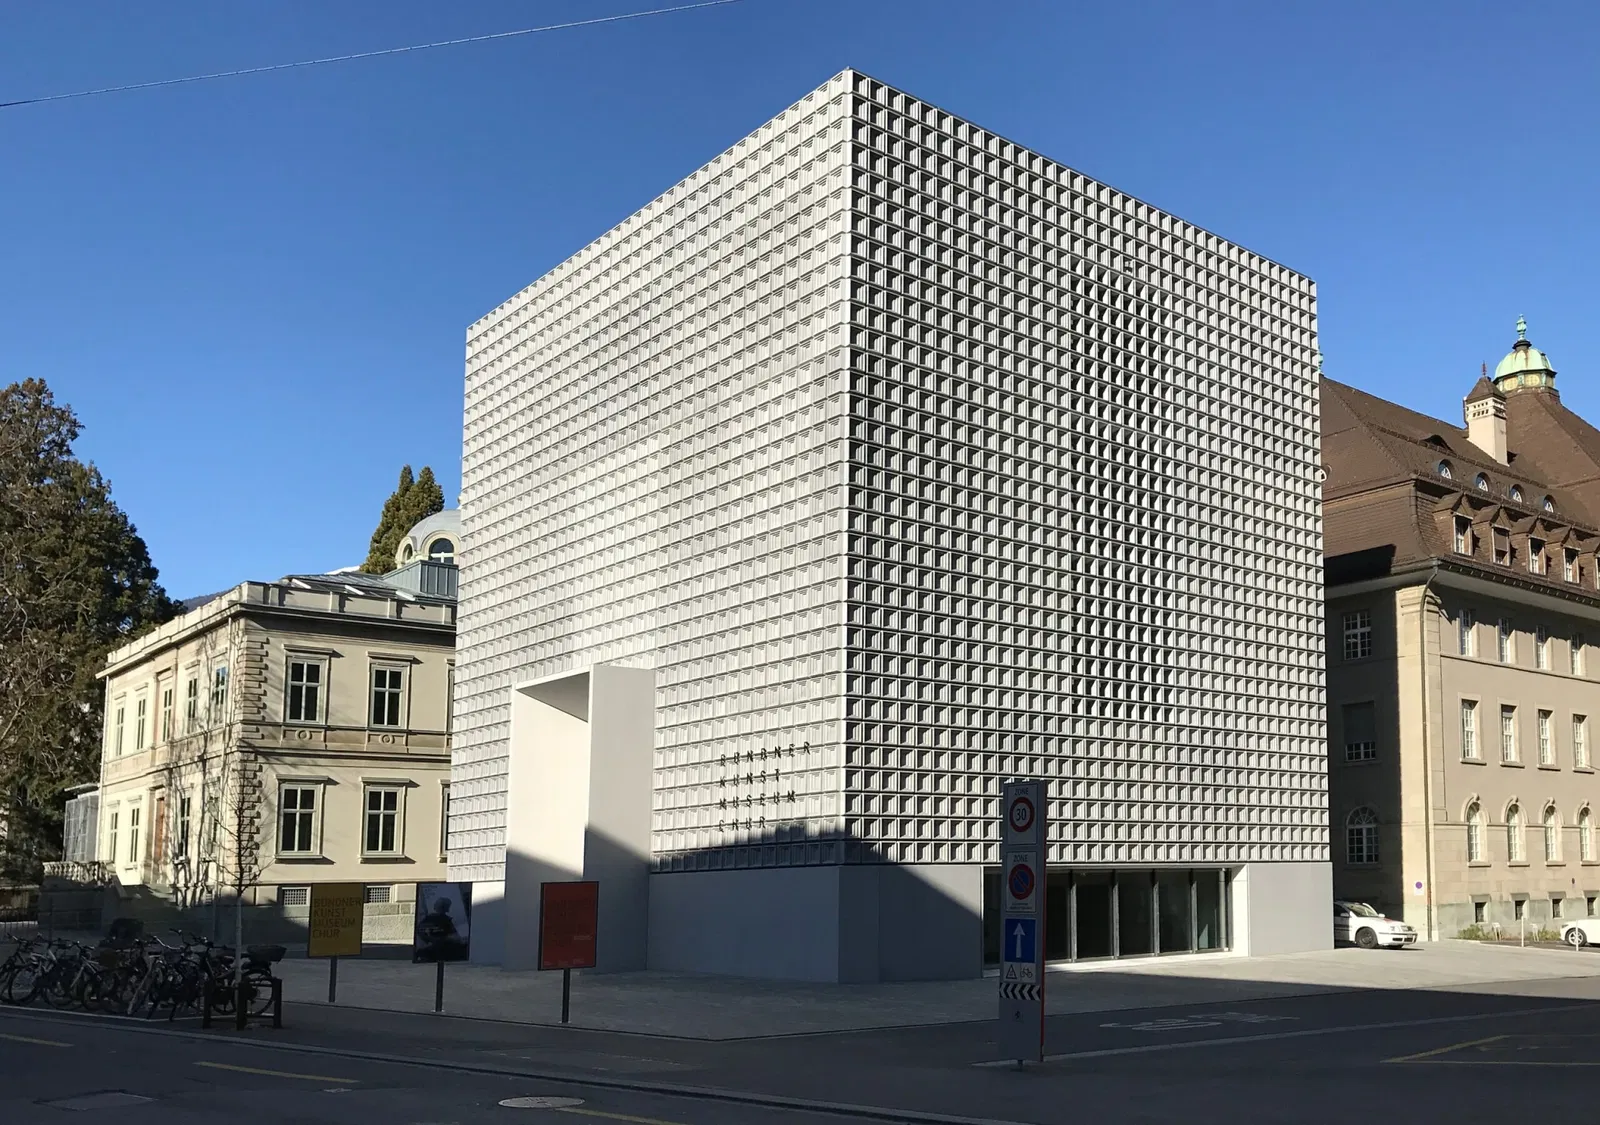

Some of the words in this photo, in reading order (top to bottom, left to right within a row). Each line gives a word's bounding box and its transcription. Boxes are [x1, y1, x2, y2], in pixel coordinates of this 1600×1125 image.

[1014, 787, 1029, 796] ZONE
[1015, 807, 1027, 822] 30
[1013, 854, 1029, 863] ZONE
[314, 907, 346, 918] KUNST
[312, 928, 341, 939] CHUR
